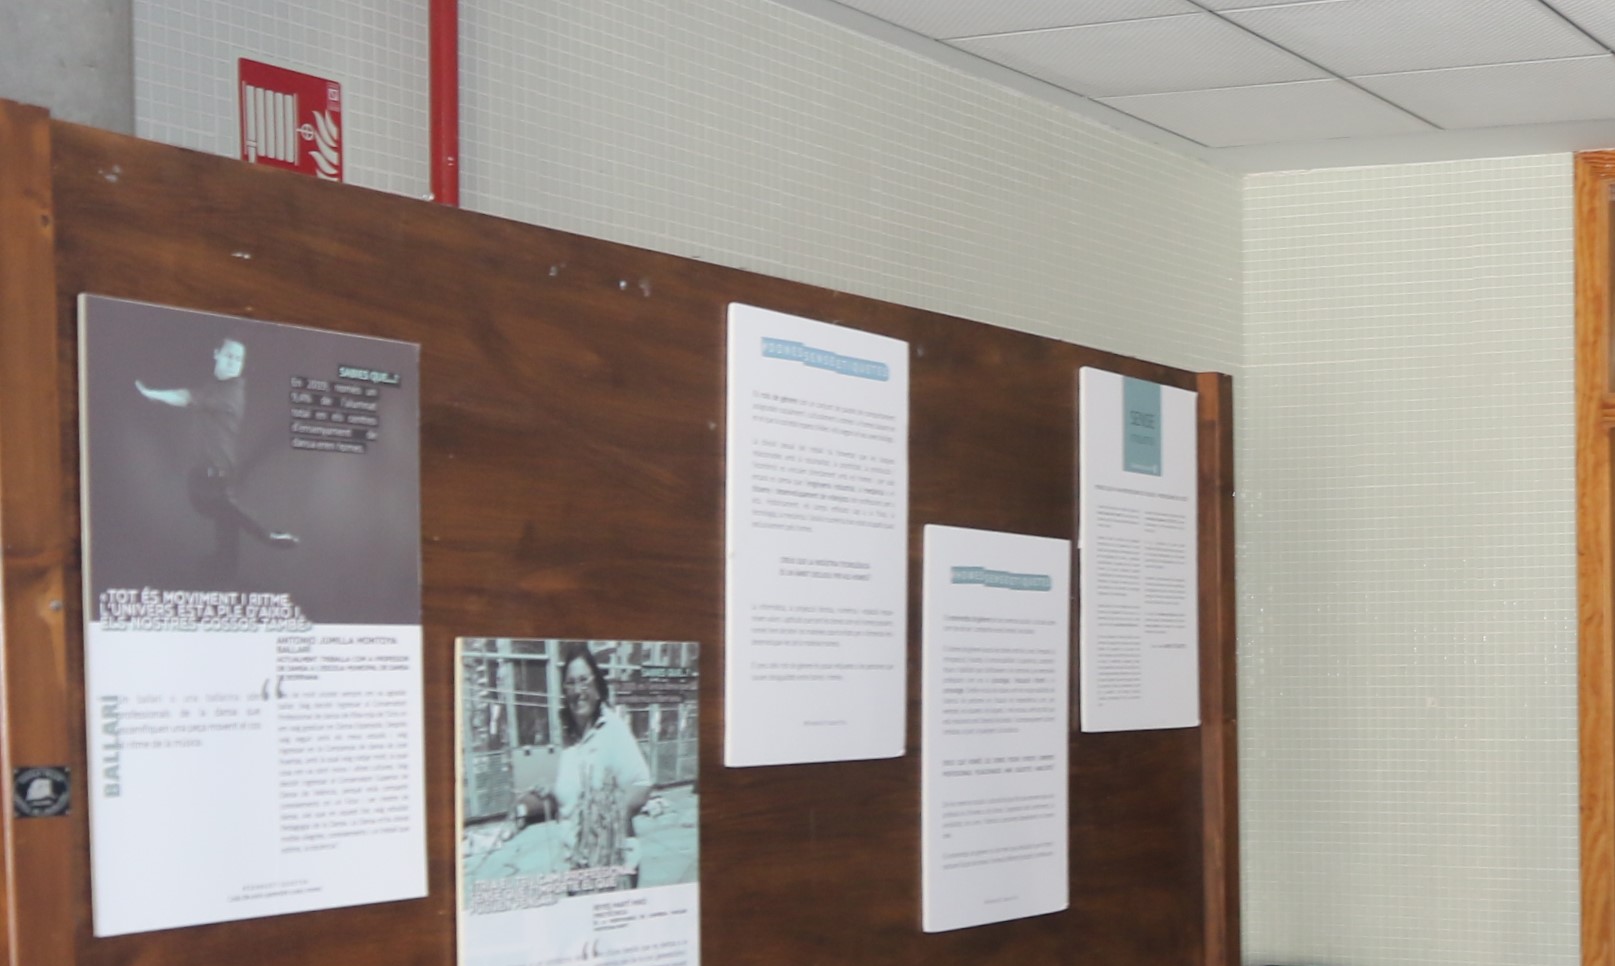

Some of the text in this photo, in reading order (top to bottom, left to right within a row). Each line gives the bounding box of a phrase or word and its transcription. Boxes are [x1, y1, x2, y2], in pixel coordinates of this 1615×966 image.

[162, 590, 241, 606] MOVIMENT
[100, 604, 174, 620] L'UNIVERS
[217, 605, 244, 619] PLE
[100, 617, 127, 631] ELS
[132, 617, 198, 631] NOSTRES
[200, 618, 258, 632] COSSOS
